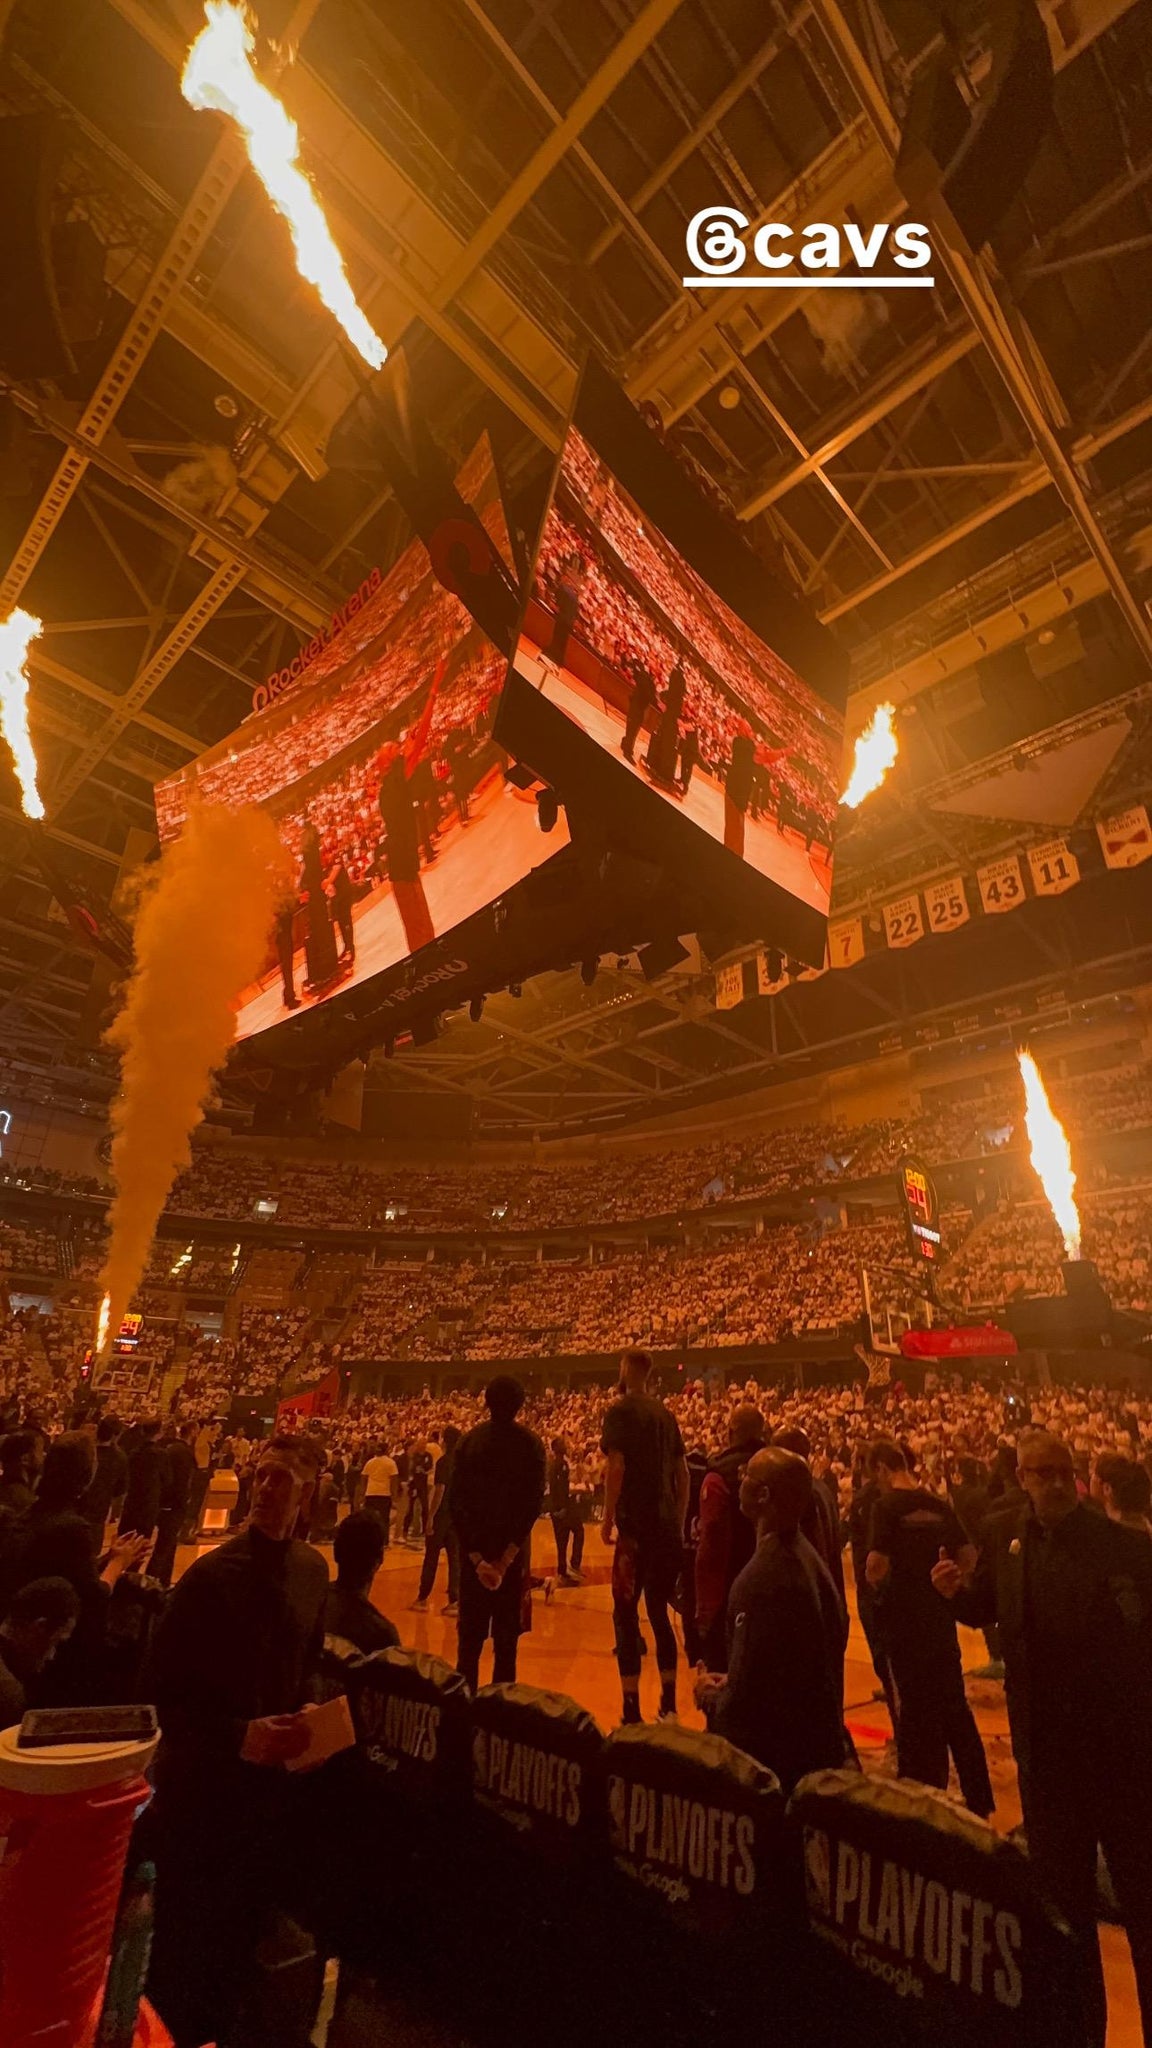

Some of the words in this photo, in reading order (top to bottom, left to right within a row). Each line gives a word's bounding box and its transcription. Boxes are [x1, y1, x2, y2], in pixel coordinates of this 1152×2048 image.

[330, 567, 383, 639] Arena
[1040, 857, 1070, 886] 11
[986, 875, 1019, 903] 43
[932, 896, 963, 925] 25
[889, 913, 919, 941] 22
[840, 936, 852, 957] 7
[119, 1320, 138, 1335] 24
[487, 1731, 581, 1826] PLAYOFFS
[628, 1783, 755, 1895] PLAYOFFS
[836, 1840, 1023, 2008] PLAYOFFS
[850, 1939, 924, 1998] Google
